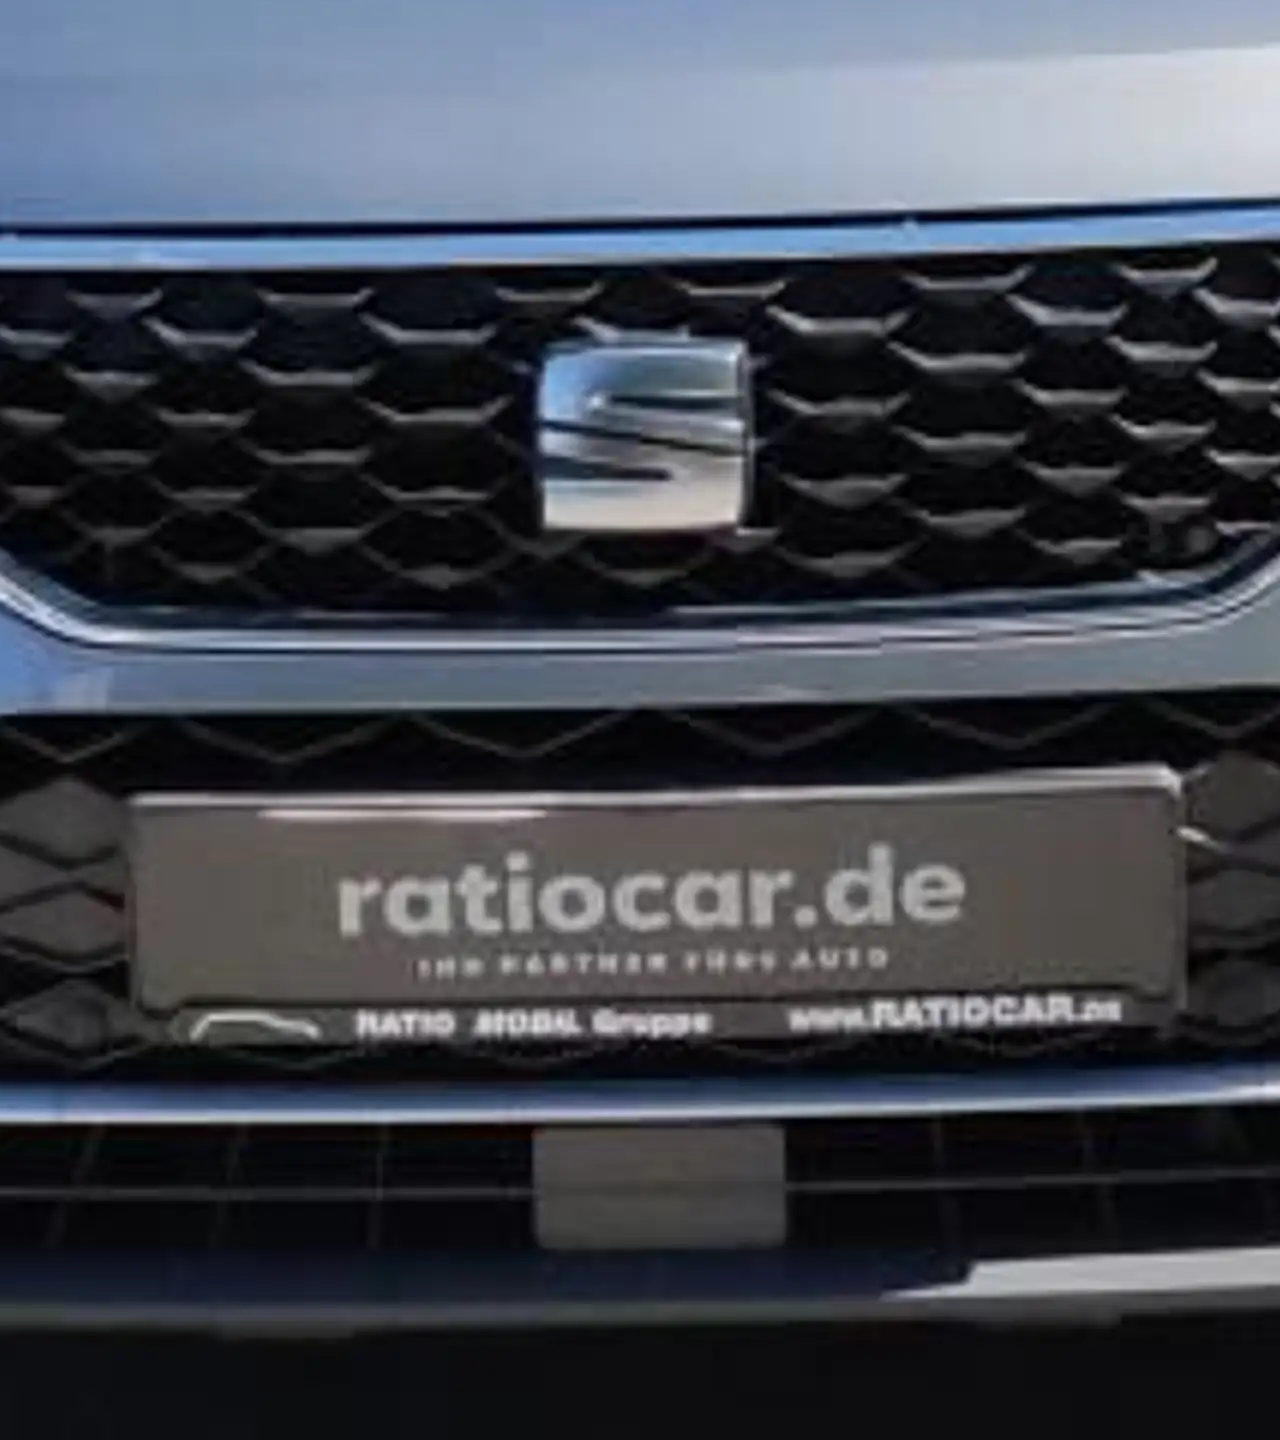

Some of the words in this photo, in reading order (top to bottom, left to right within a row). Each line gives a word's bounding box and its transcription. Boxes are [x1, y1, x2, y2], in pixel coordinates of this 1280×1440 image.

[338, 841, 968, 938] ratiocar.de
[790, 946, 889, 972] AUTO
[356, 1008, 456, 1038] RATIO
[474, 1007, 583, 1037] MOBIL
[591, 1007, 713, 1041] Gruppe
